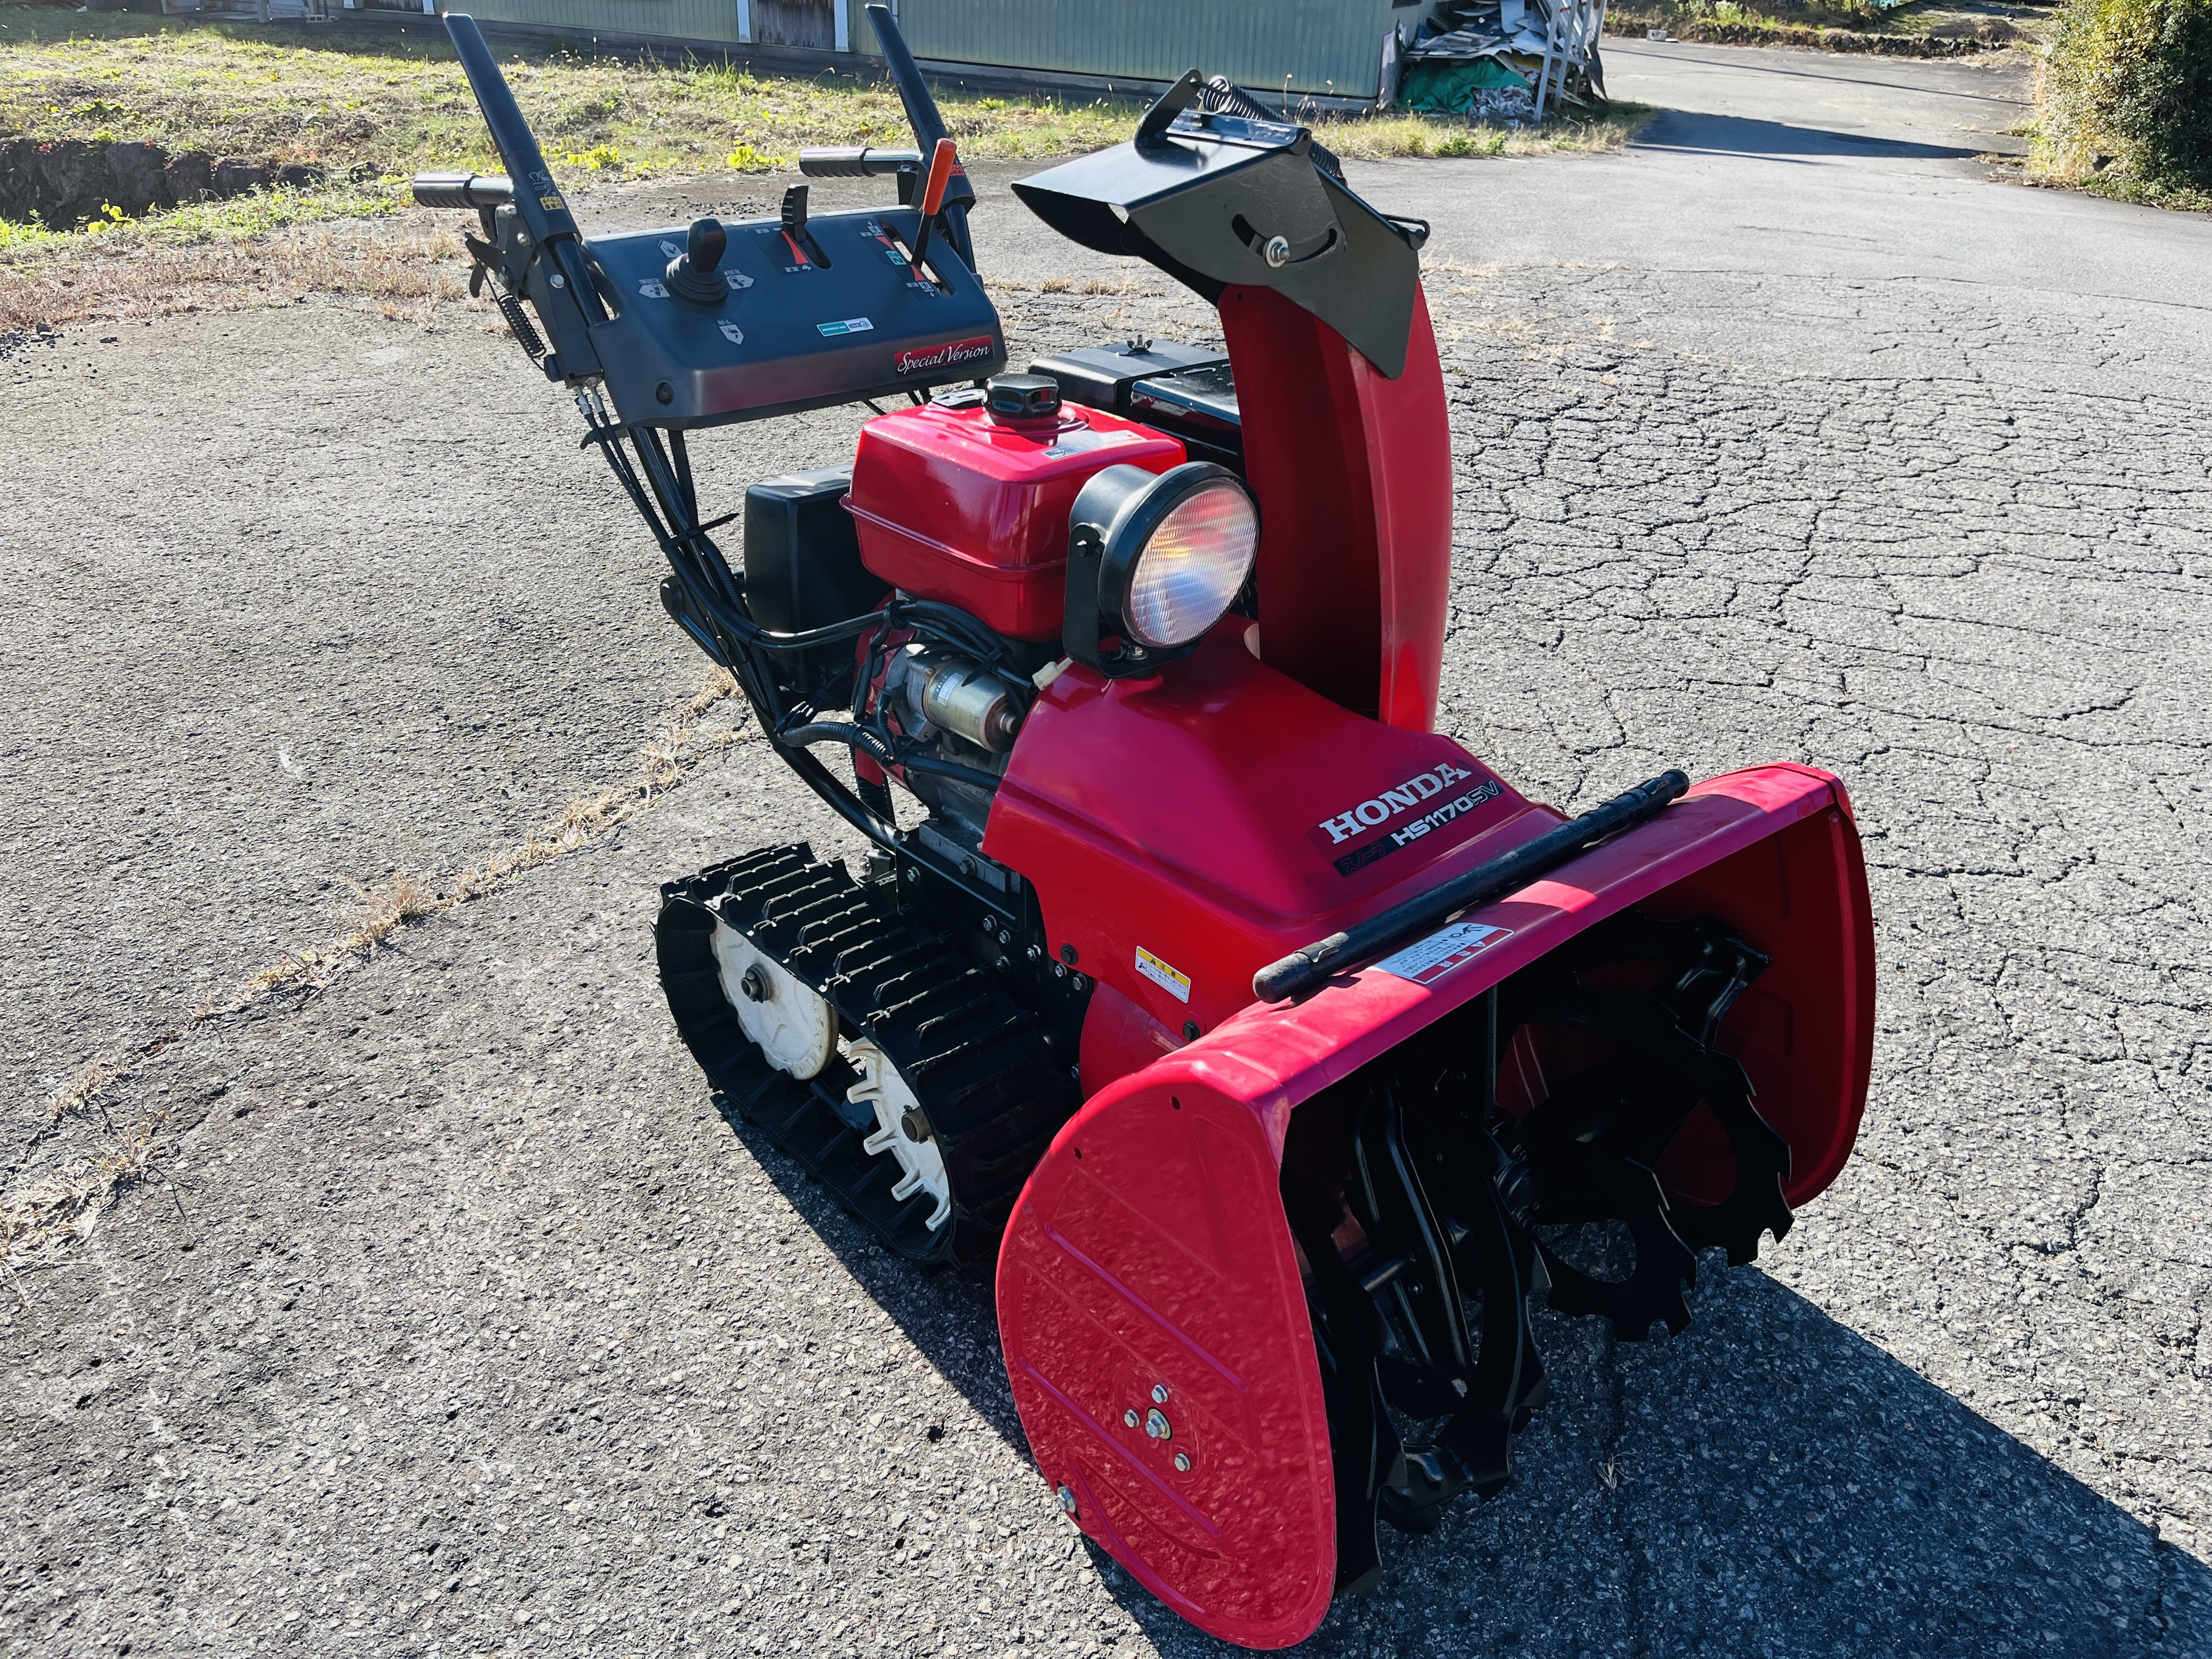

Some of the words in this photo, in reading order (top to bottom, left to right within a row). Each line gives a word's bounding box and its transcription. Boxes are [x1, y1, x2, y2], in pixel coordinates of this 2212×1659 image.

[898, 348, 945, 374] Special
[946, 344, 990, 363] Version
[1319, 762, 1471, 844] HONDA
[1340, 841, 1386, 873] スノーラ
[1390, 780, 1500, 846] HS1170SV
